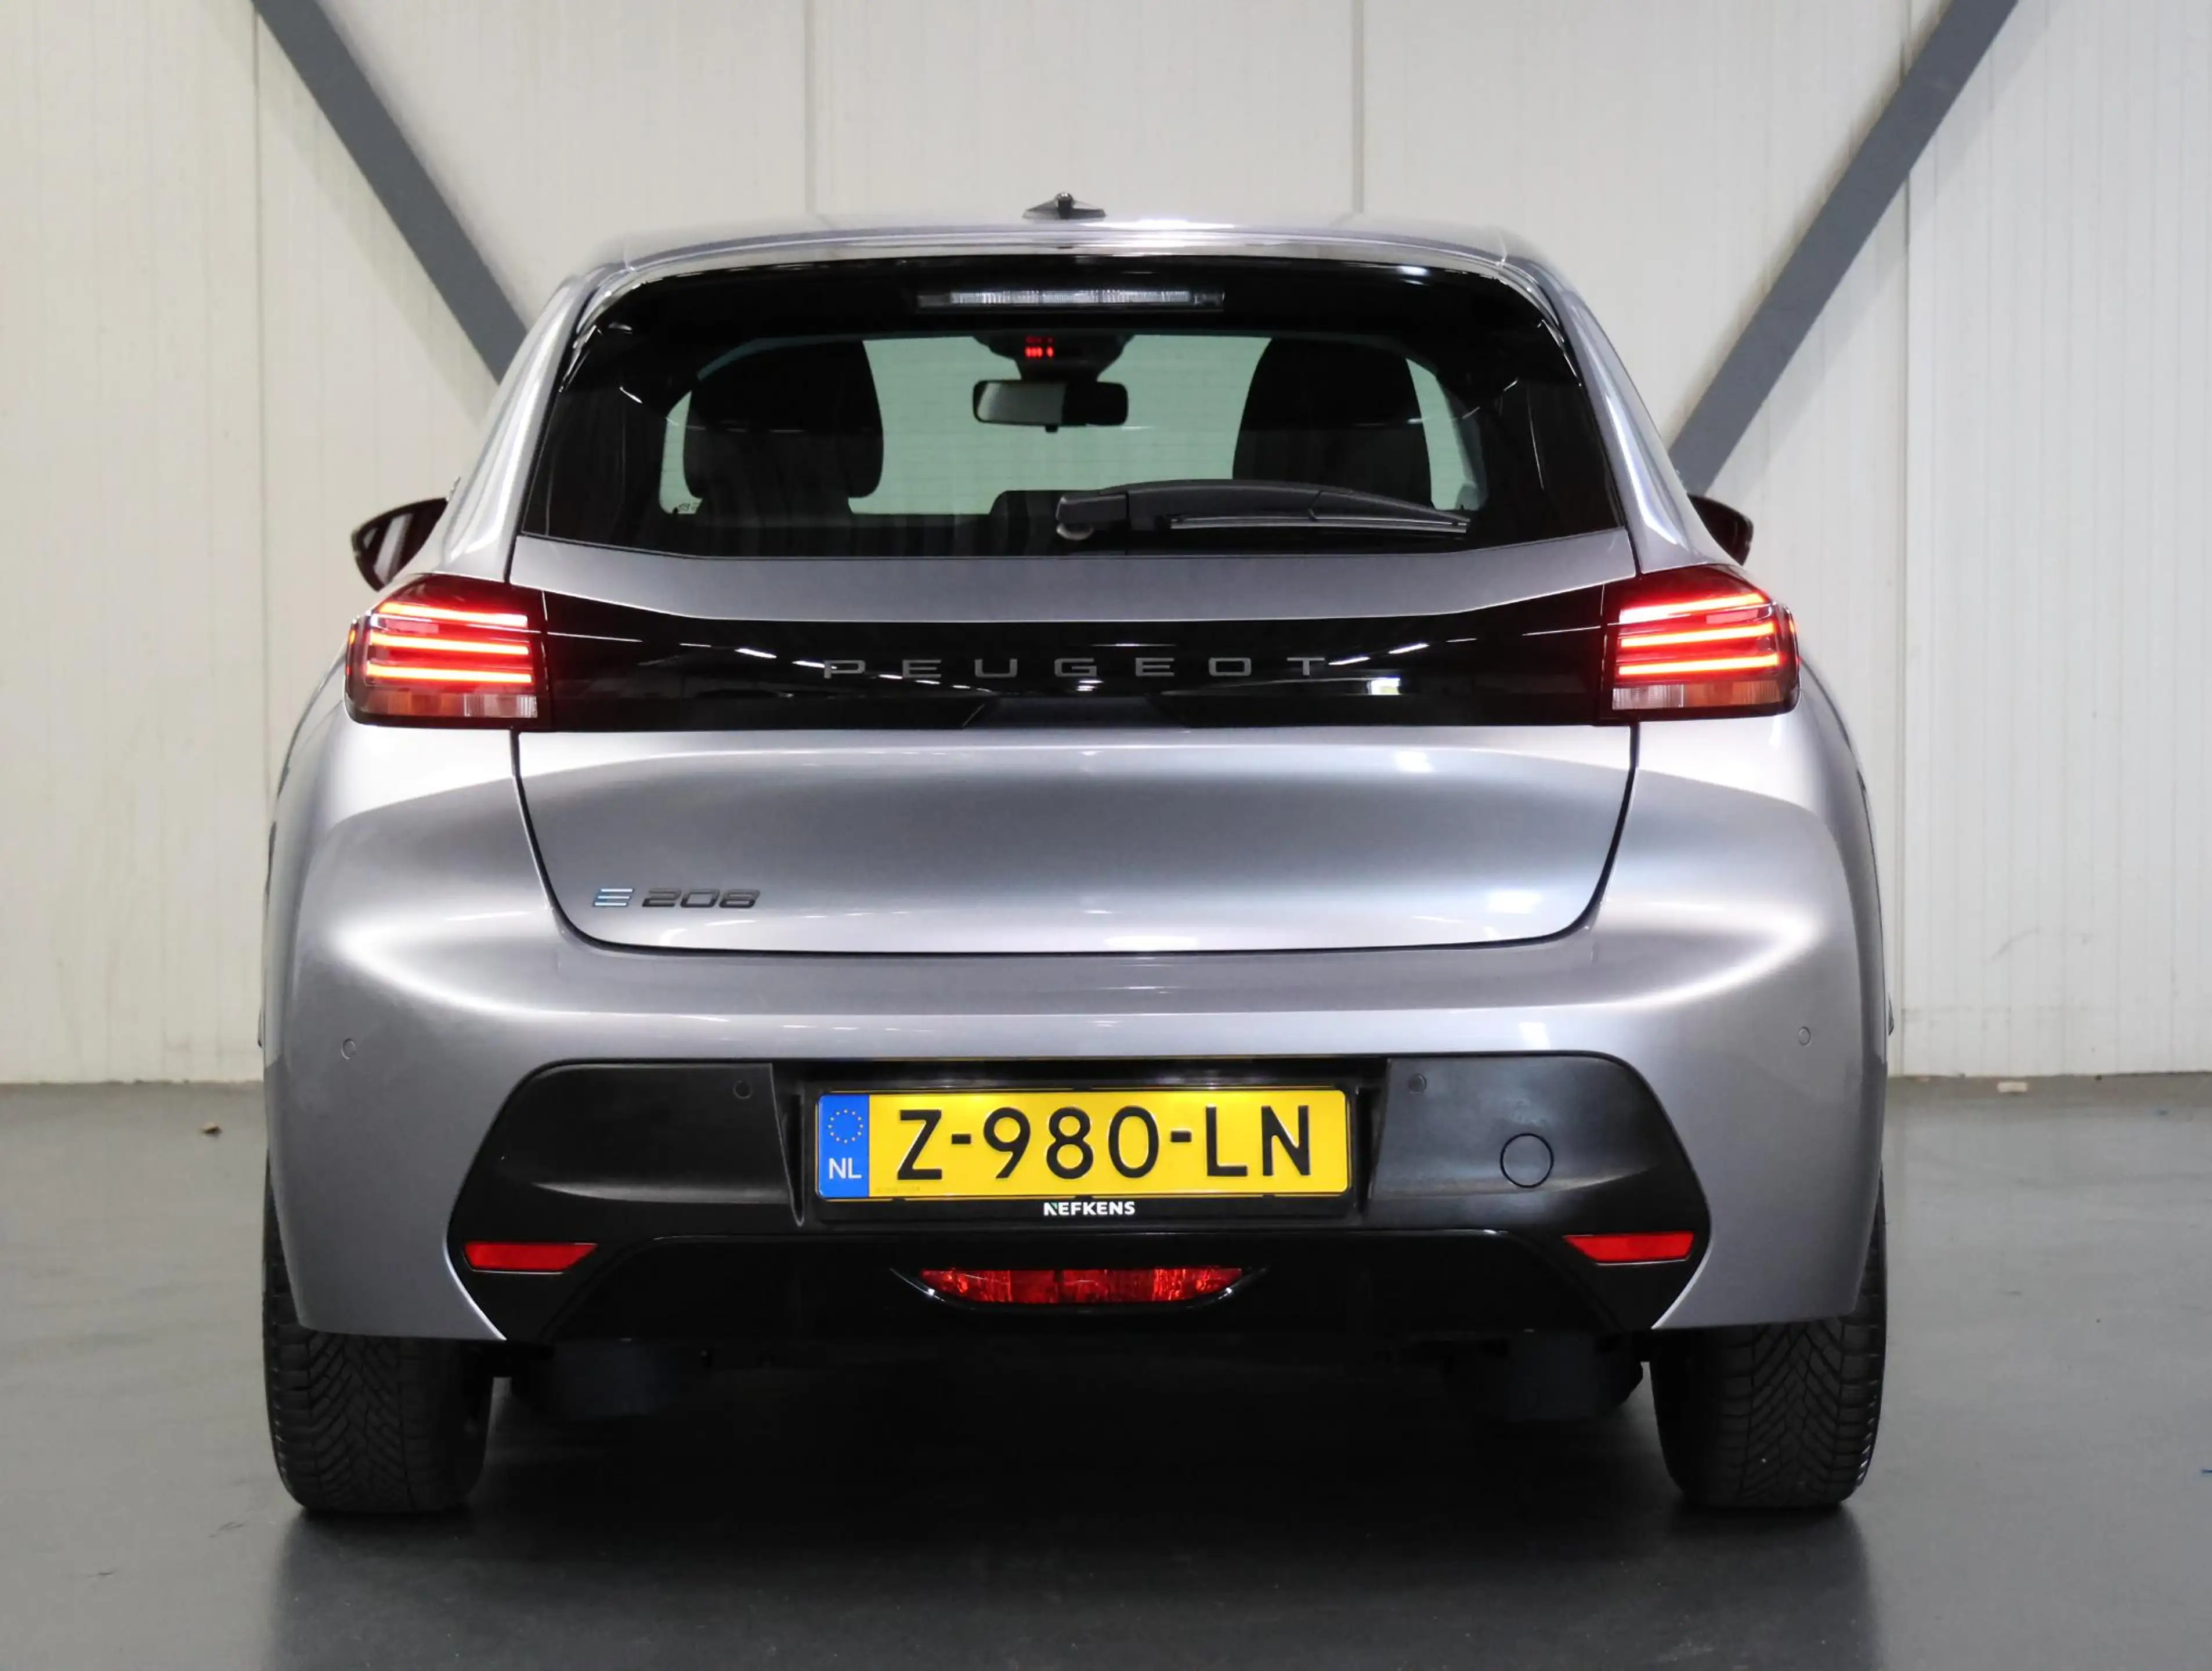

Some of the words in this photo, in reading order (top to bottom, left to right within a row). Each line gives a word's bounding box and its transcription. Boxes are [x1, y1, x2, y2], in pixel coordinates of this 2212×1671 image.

[823, 656, 1325, 679] PEUGEOT
[642, 888, 761, 909] 208
[897, 1105, 1311, 1180] Z-980-LN
[828, 1157, 863, 1180] NL
[1043, 1200, 1136, 1216] NEFKENS
